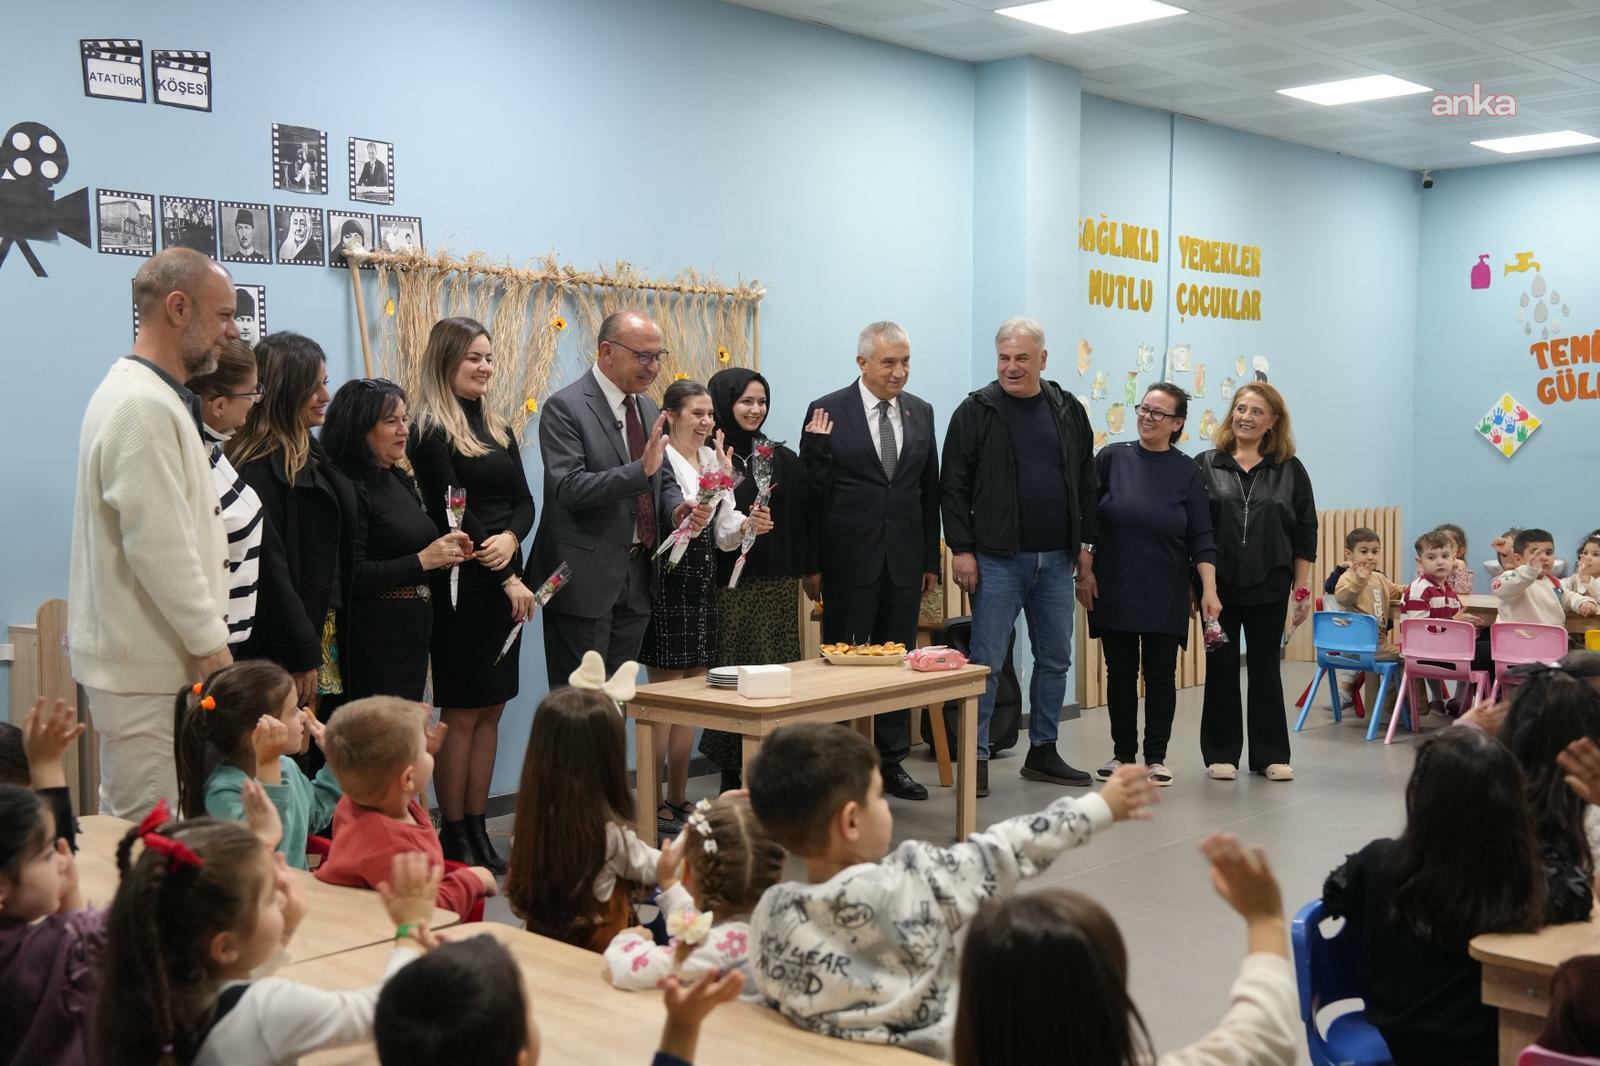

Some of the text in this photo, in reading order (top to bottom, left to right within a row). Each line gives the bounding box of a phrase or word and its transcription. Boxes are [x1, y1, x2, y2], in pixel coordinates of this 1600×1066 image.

[89, 71, 142, 87] ATATÜRK
[158, 77, 208, 96] KÖŞESİ
[1078, 212, 1262, 278] AĞLIKLI YEMEKLER
[1088, 268, 1262, 324] MUTLU ÇOCUKLAR
[1537, 368, 1600, 405] GÜL
